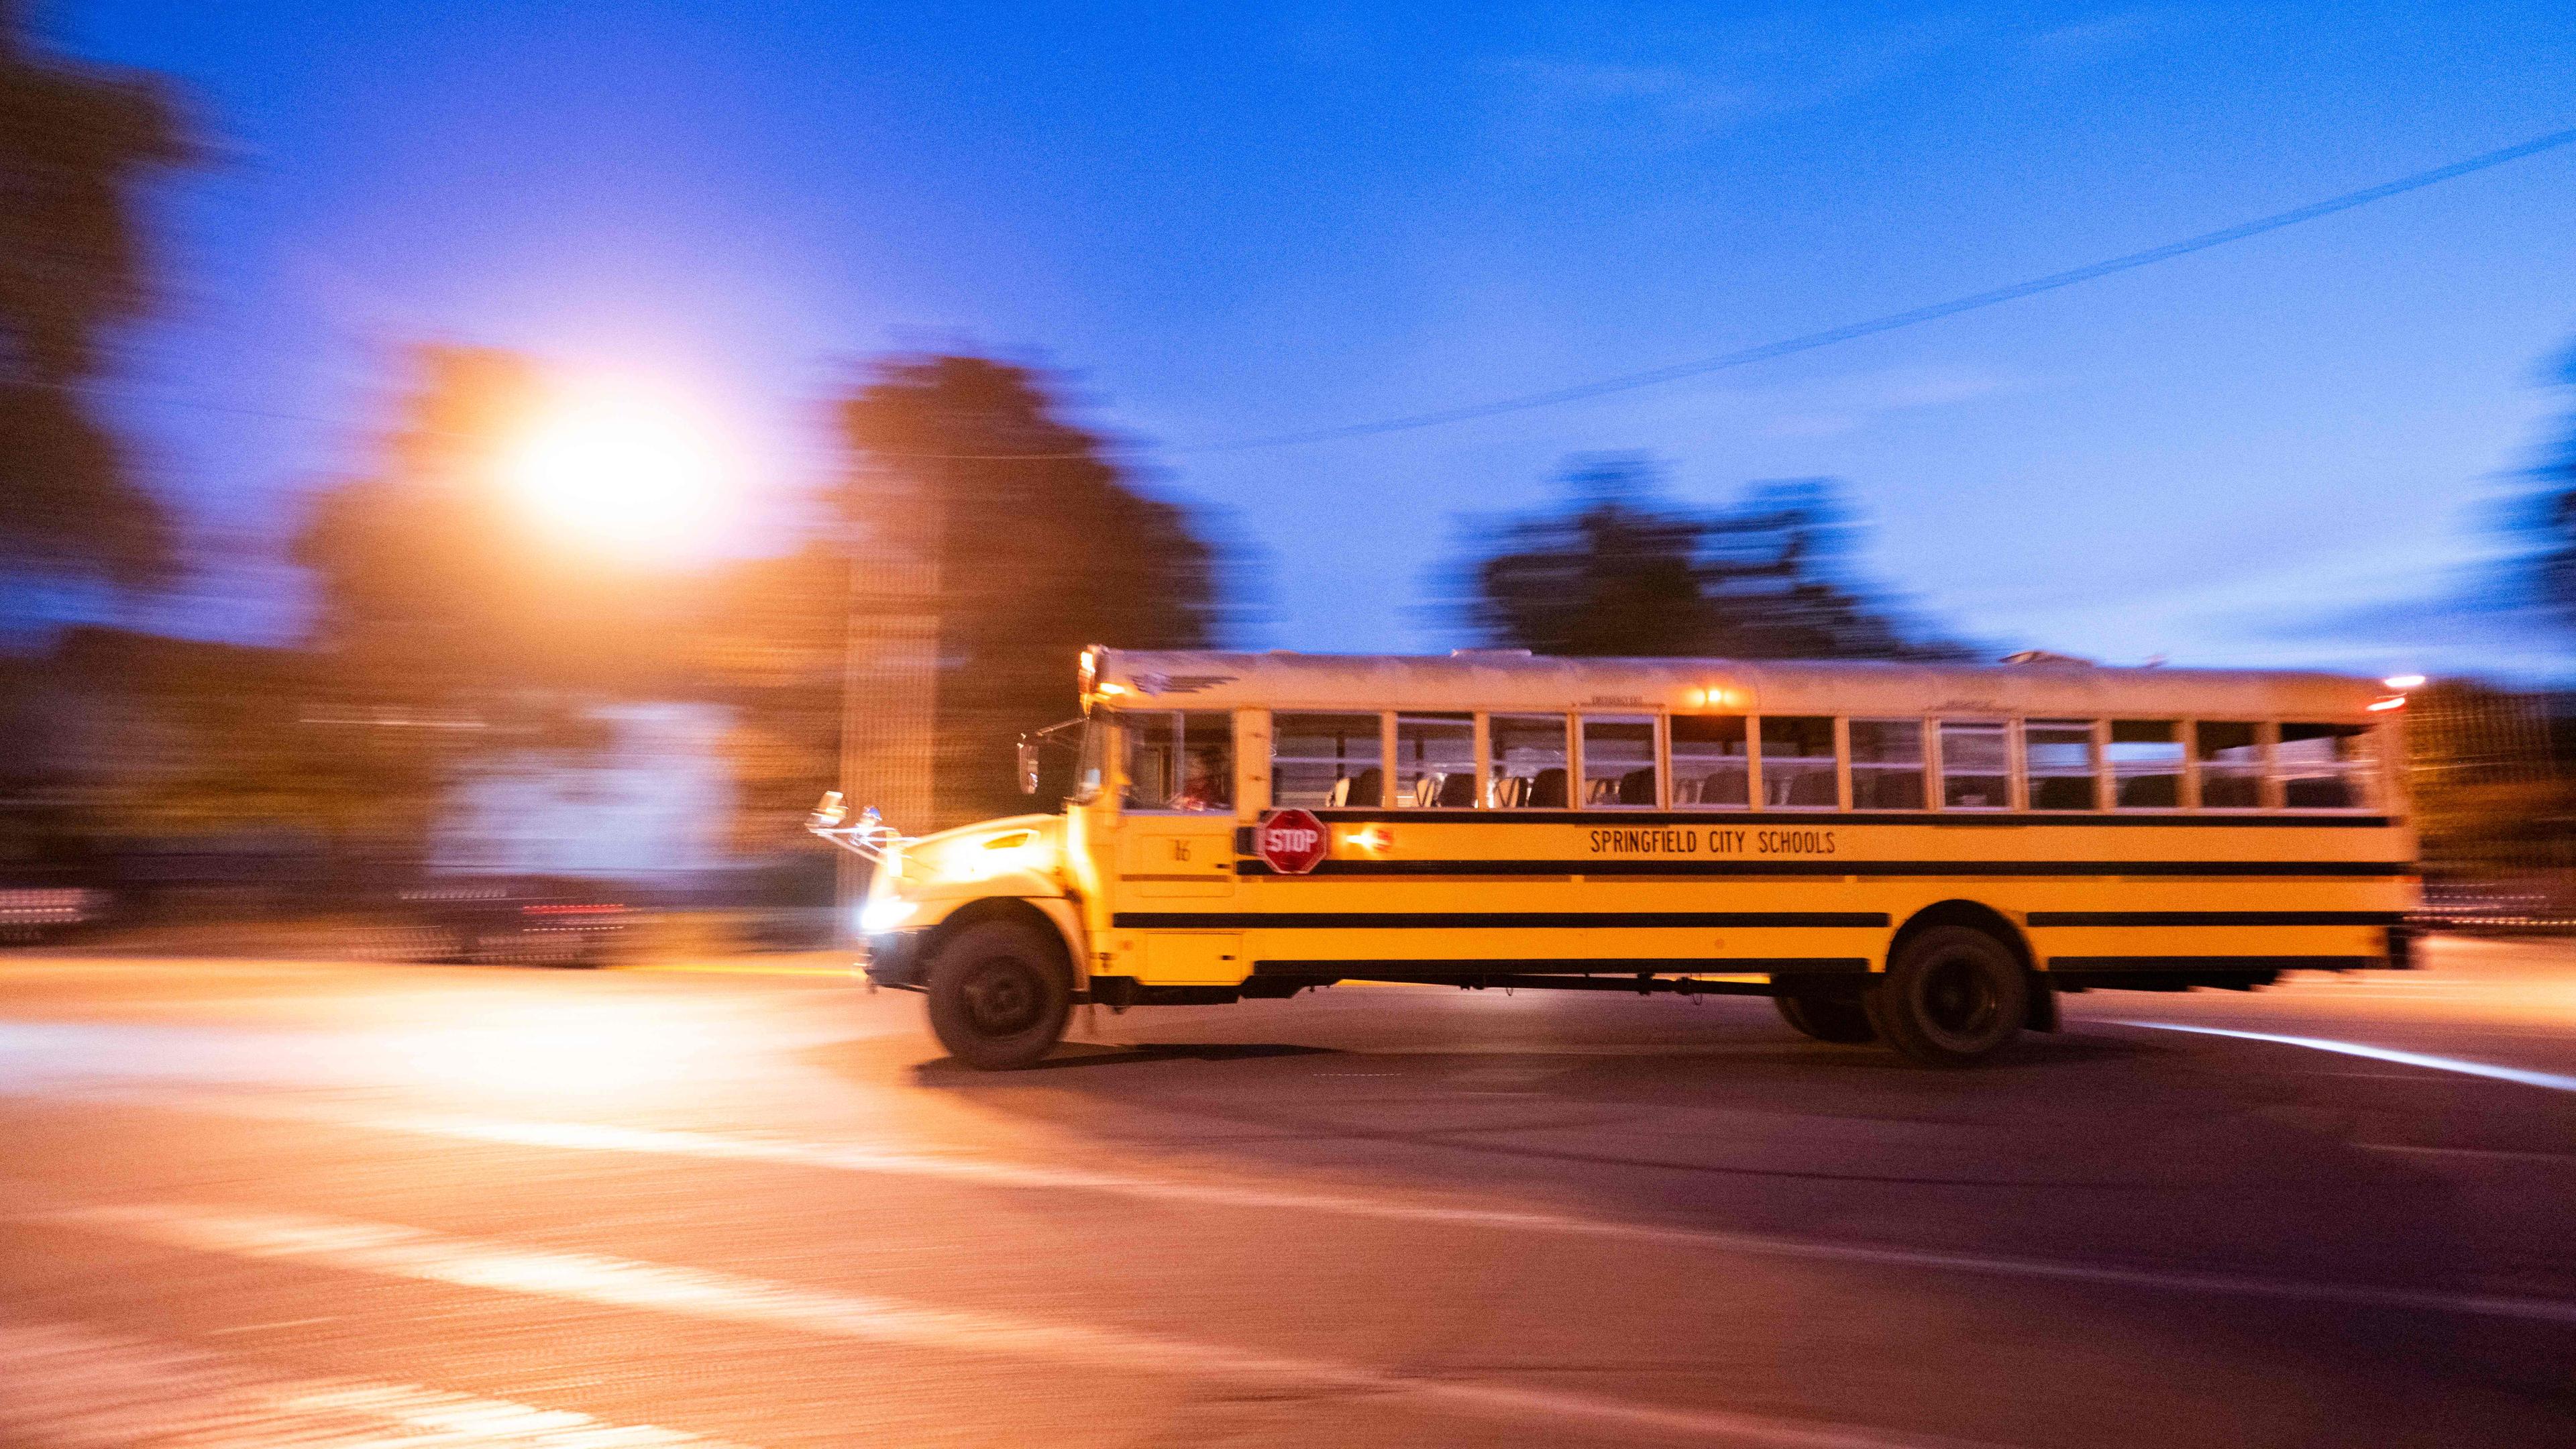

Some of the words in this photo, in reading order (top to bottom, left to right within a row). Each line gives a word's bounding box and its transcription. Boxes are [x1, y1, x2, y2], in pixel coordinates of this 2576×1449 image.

[1267, 828, 1318, 853] STOP
[1591, 830, 1697, 853] SPRINGFIELD
[1709, 830, 1746, 853] CITY
[1758, 831, 1835, 854] SCHOOLS
